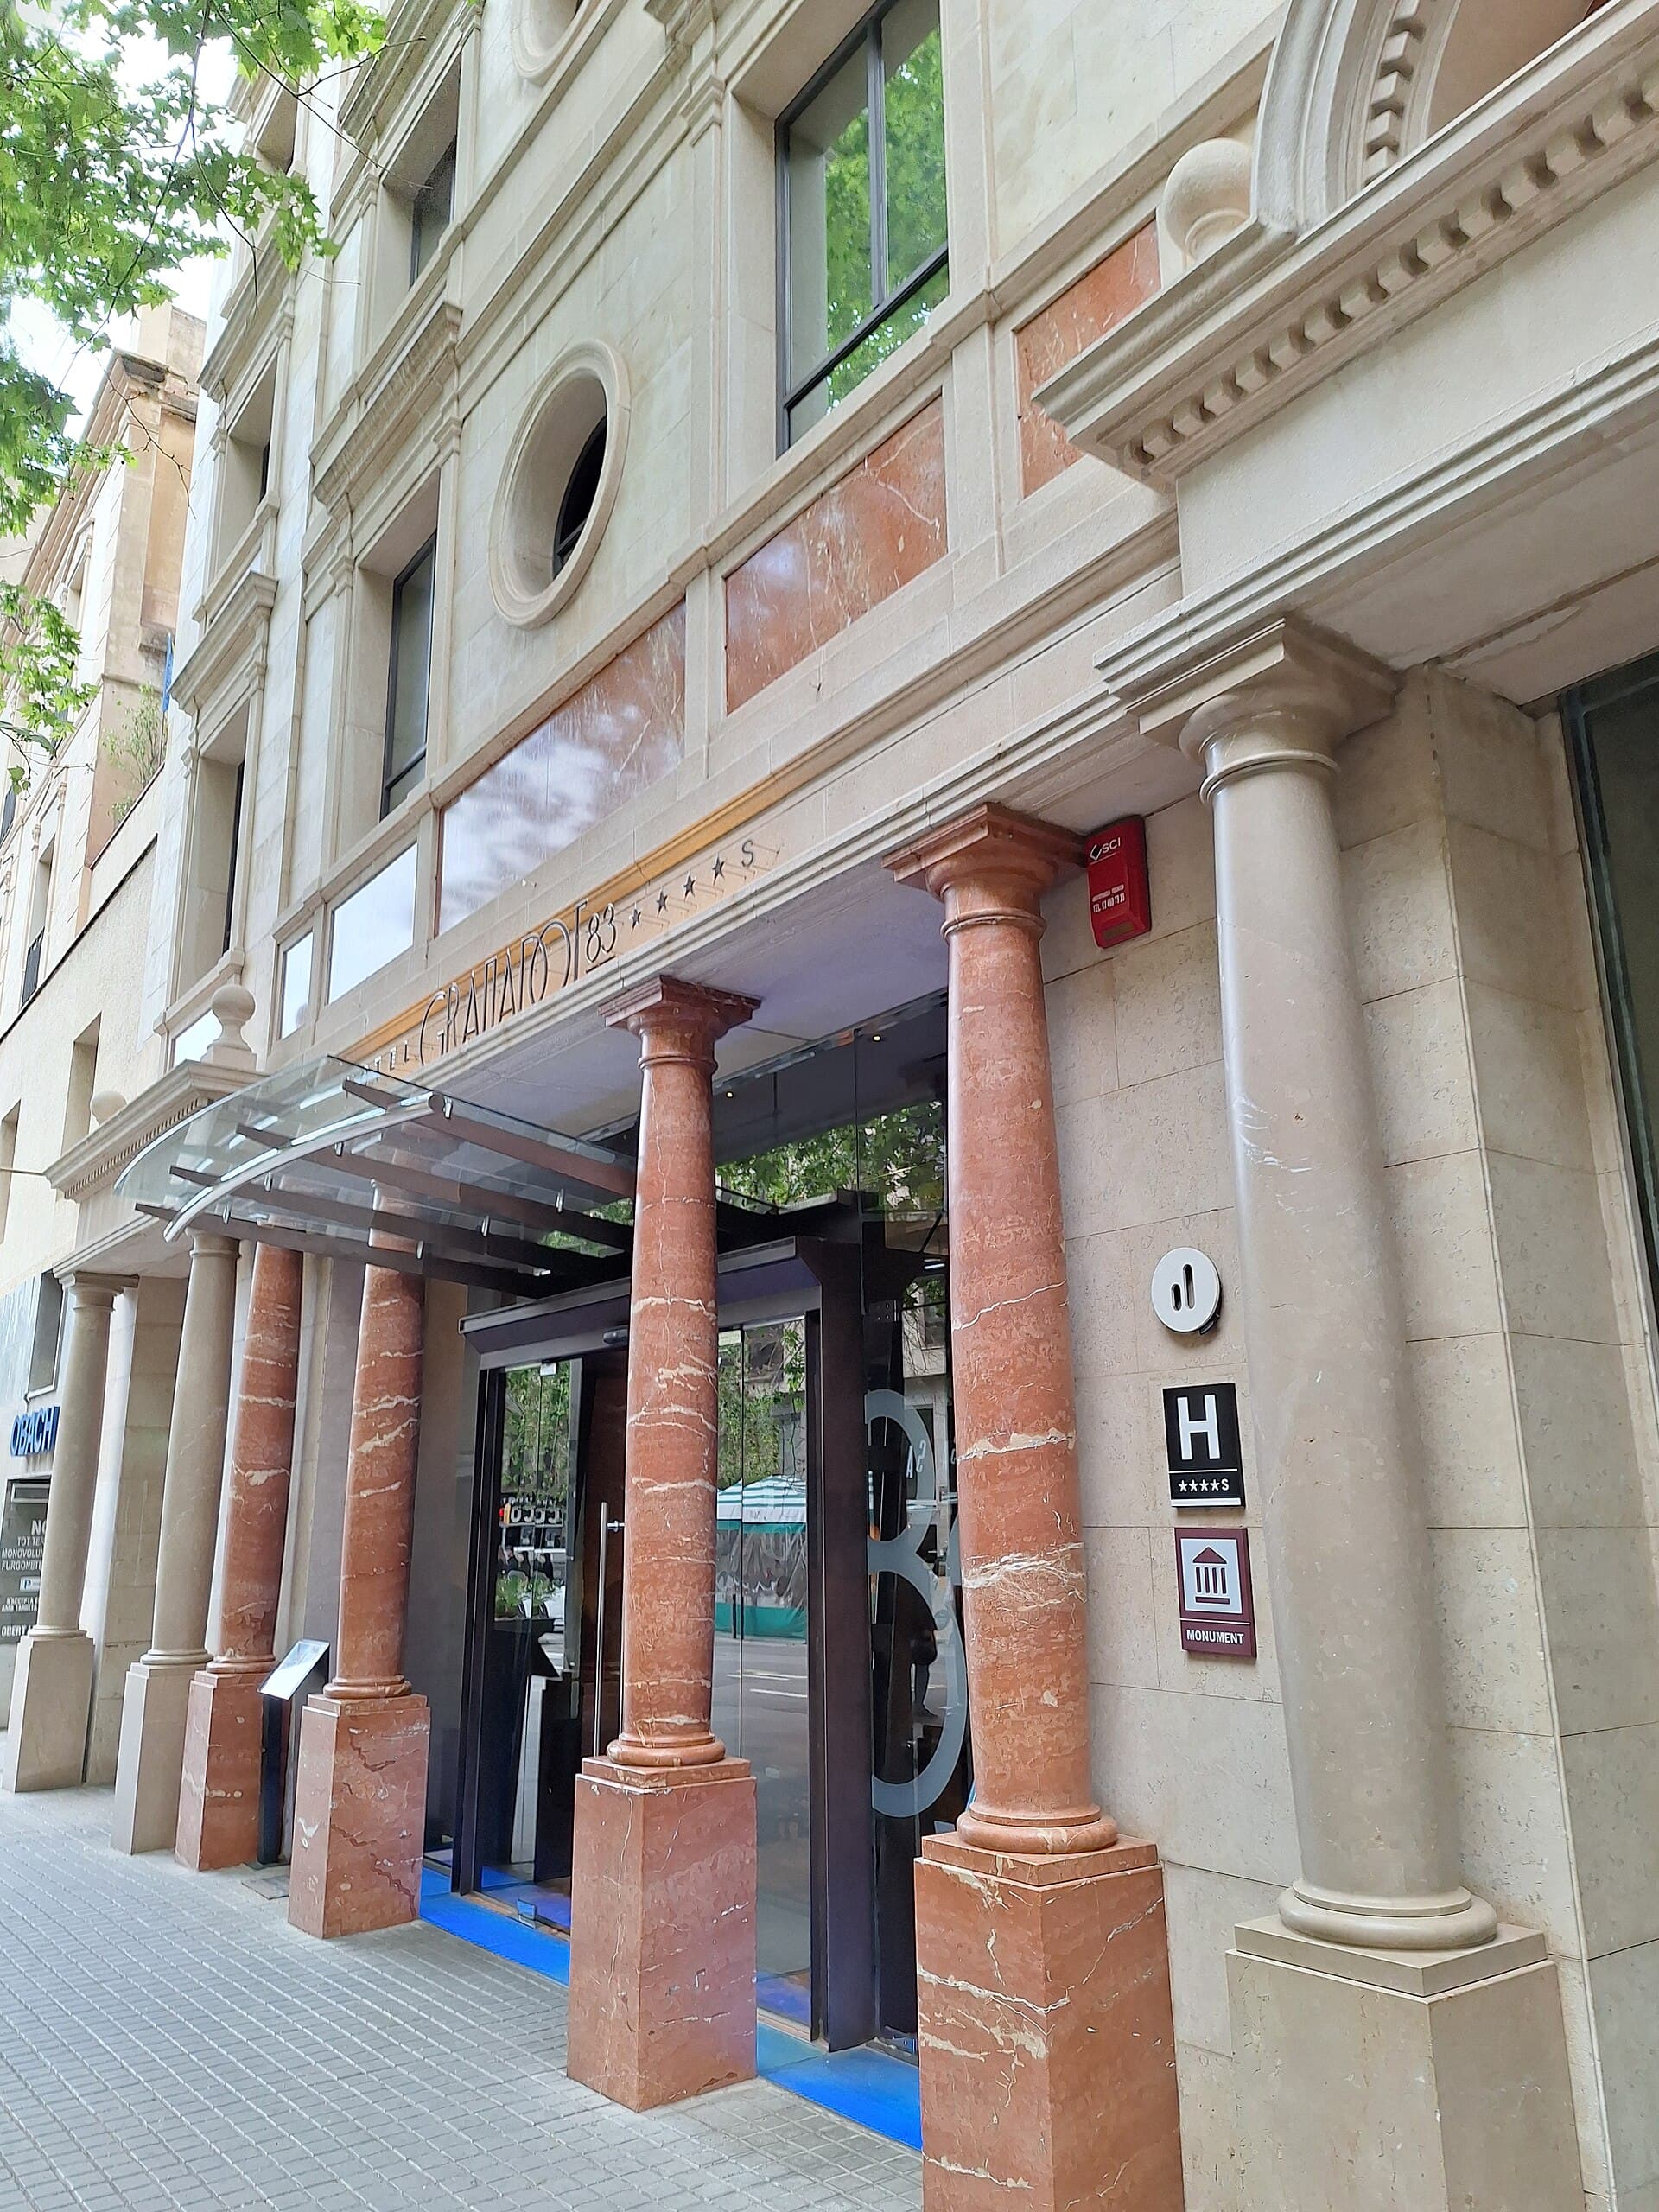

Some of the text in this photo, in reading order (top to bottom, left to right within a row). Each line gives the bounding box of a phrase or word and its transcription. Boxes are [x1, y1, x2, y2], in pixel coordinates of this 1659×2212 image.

[1102, 836, 1121, 855] SCI
[586, 902, 617, 964] 83
[10, 1407, 56, 1457] OBACH
[1177, 1394, 1221, 1460] H
[1186, 1629, 1244, 1644] MONUMENT
